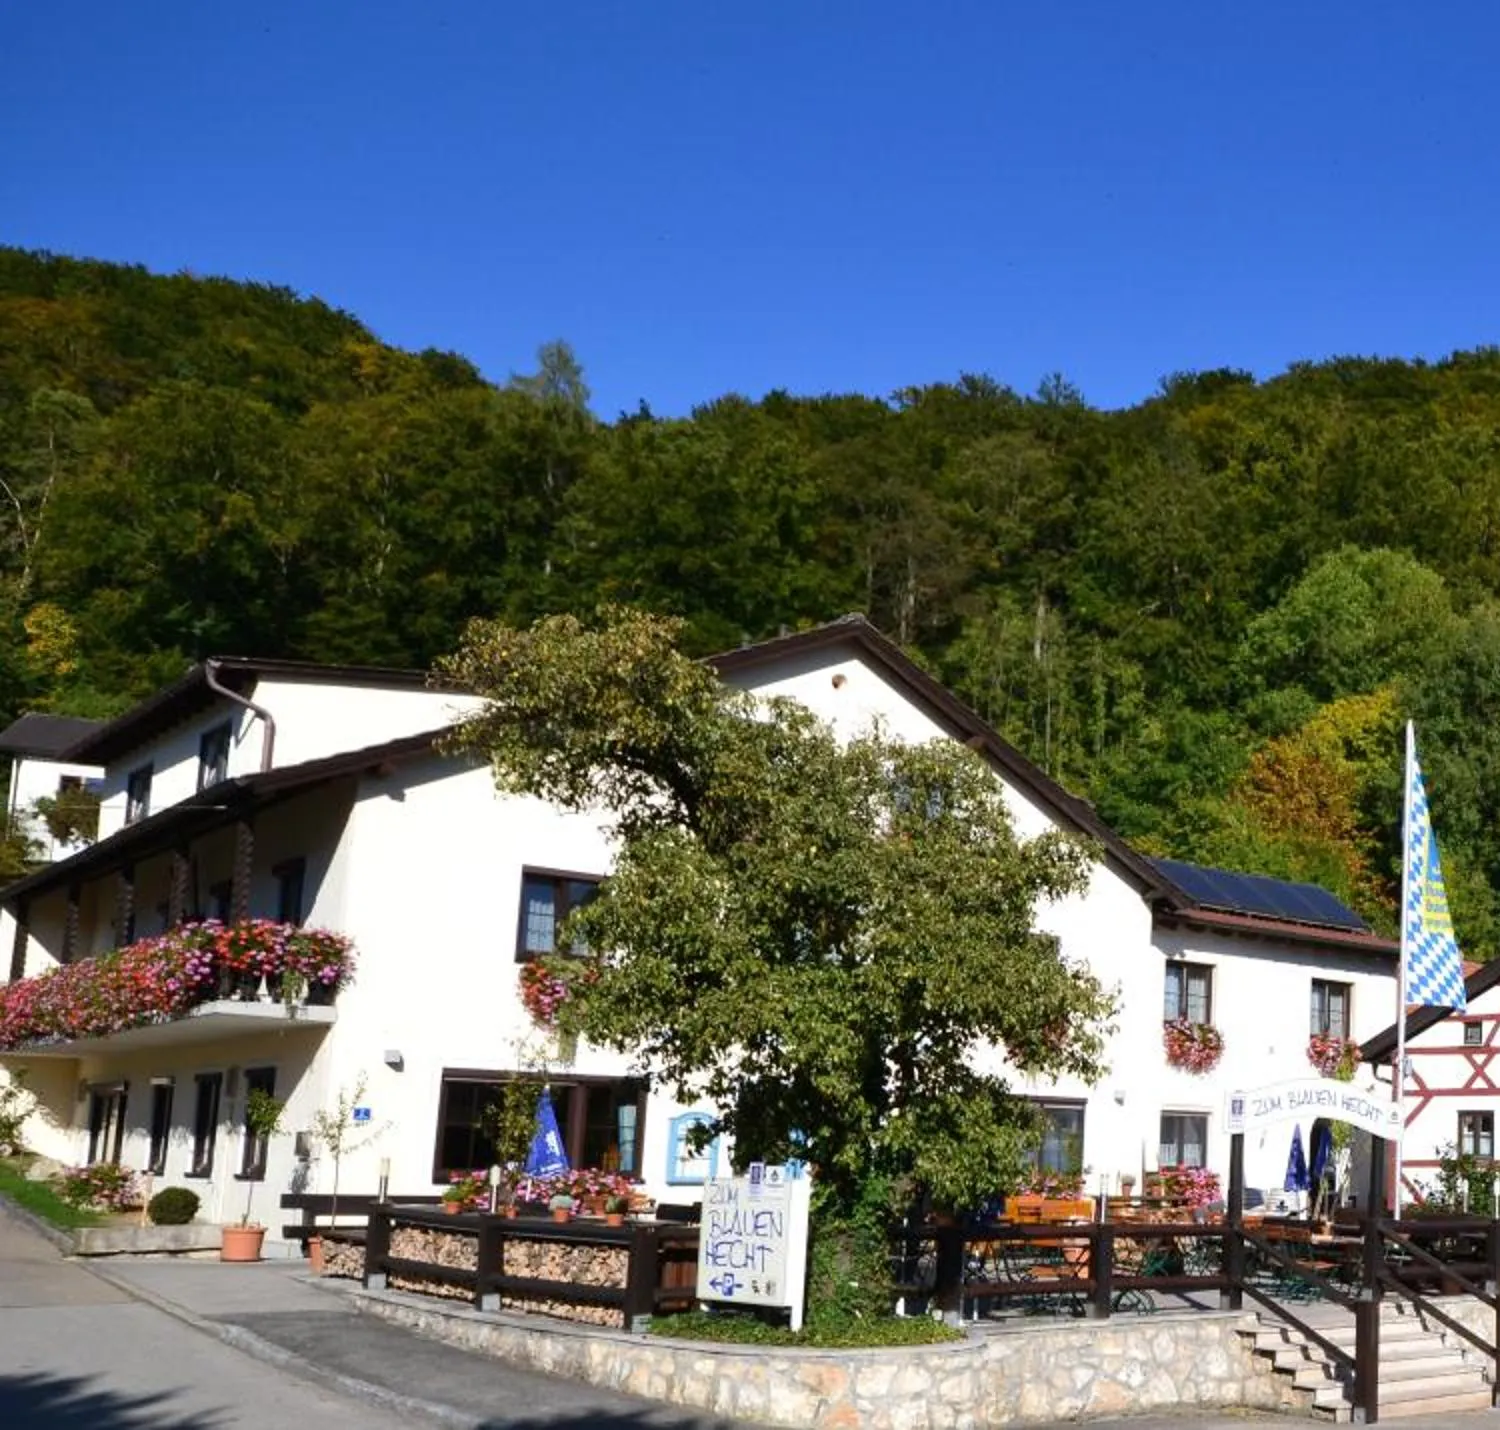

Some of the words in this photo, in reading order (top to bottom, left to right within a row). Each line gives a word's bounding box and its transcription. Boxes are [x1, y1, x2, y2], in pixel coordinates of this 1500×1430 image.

[1253, 1097, 1282, 1117] ZUM
[1288, 1089, 1337, 1110] BLAUEN
[1341, 1093, 1384, 1122] HECHT
[709, 1182, 739, 1205] ZUM
[707, 1209, 782, 1239] BLAUEN
[705, 1239, 774, 1272] HECHT
